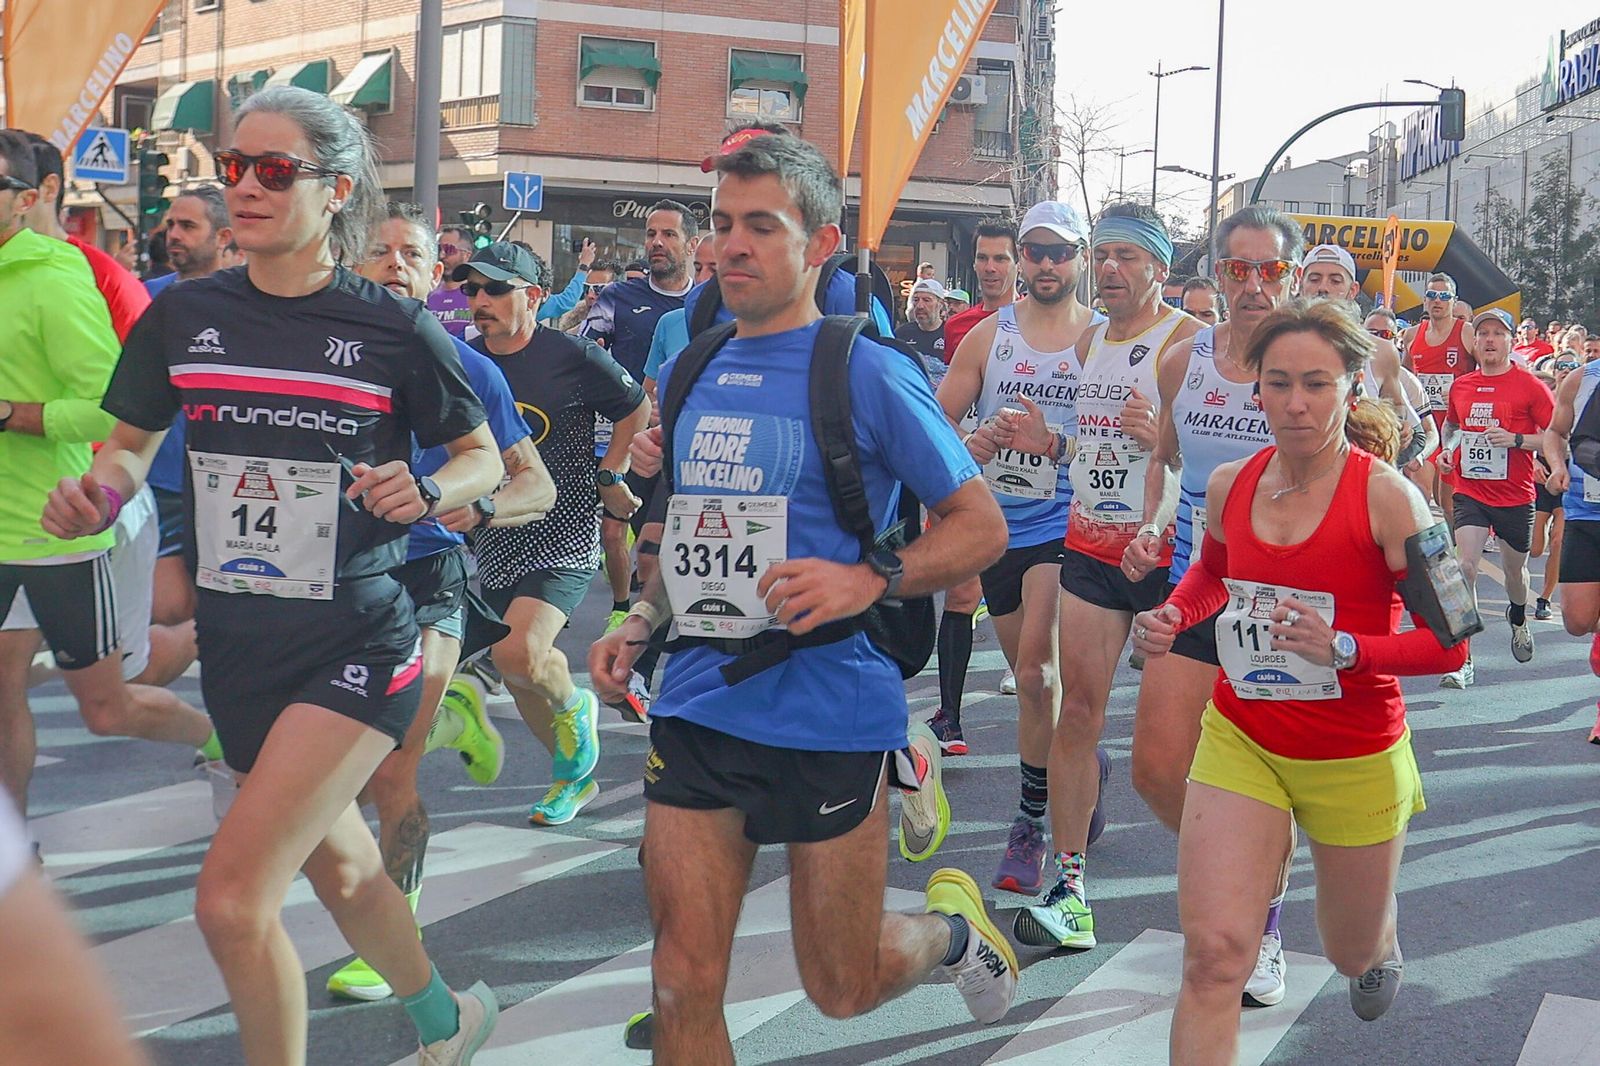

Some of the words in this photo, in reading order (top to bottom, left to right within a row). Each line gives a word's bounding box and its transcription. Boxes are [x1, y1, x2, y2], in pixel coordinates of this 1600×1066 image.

[997, 381, 1078, 402] MARACEN
[1184, 411, 1273, 435] MARACEN
[1470, 408, 1493, 418] PADRE
[695, 416, 754, 436] MEMORIAL
[1225, 433, 1270, 443] ATLETISMO
[689, 433, 752, 464] PADRE
[1469, 448, 1492, 460] 561
[1088, 469, 1128, 489] 367
[231, 503, 277, 539] 14
[256, 542, 281, 553] GALA
[674, 543, 757, 578] 3314
[701, 581, 726, 592] DIEGO
[1250, 654, 1287, 664] LOURDES
[1256, 673, 1275, 681] CAJÓN
[976, 940, 1007, 978] HOKA
